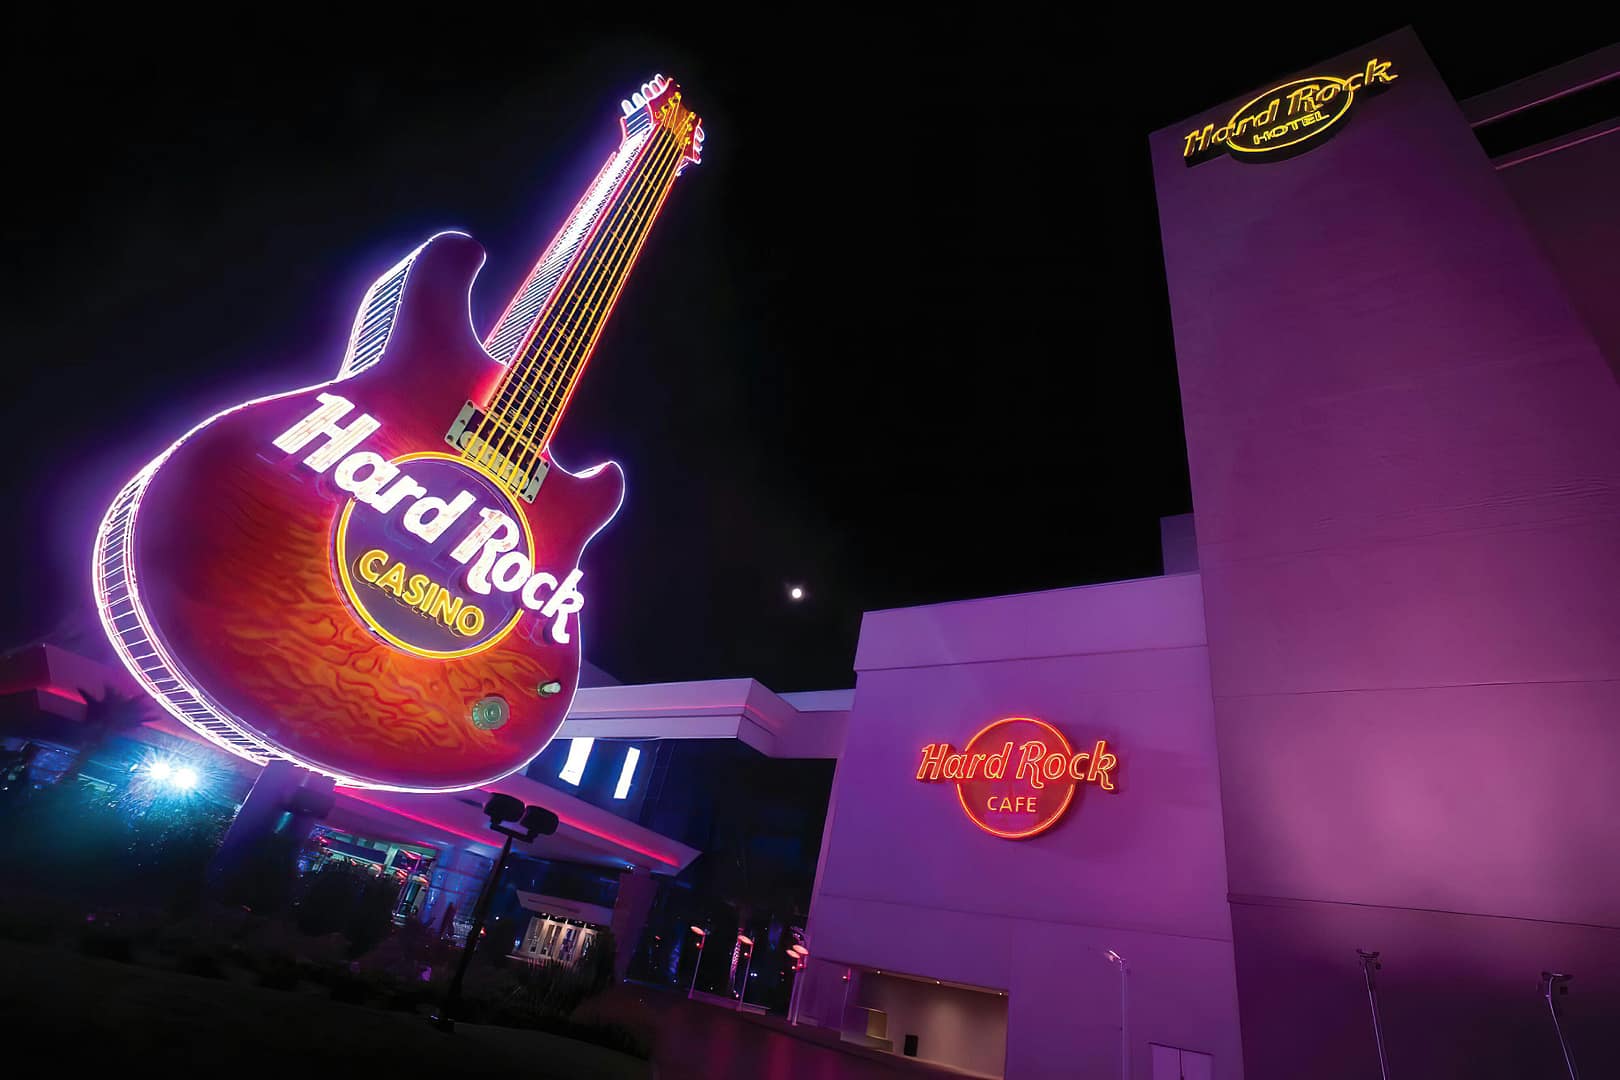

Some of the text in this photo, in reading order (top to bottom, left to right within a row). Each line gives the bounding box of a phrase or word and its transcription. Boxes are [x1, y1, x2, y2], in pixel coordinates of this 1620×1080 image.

[1184, 58, 1399, 157] Hard Rock
[1253, 111, 1330, 145] HOTEL
[272, 392, 585, 644] Hard Rock
[359, 549, 485, 636] CASINO
[916, 740, 1117, 790] Hard Rock
[987, 796, 1037, 813] CAFE
